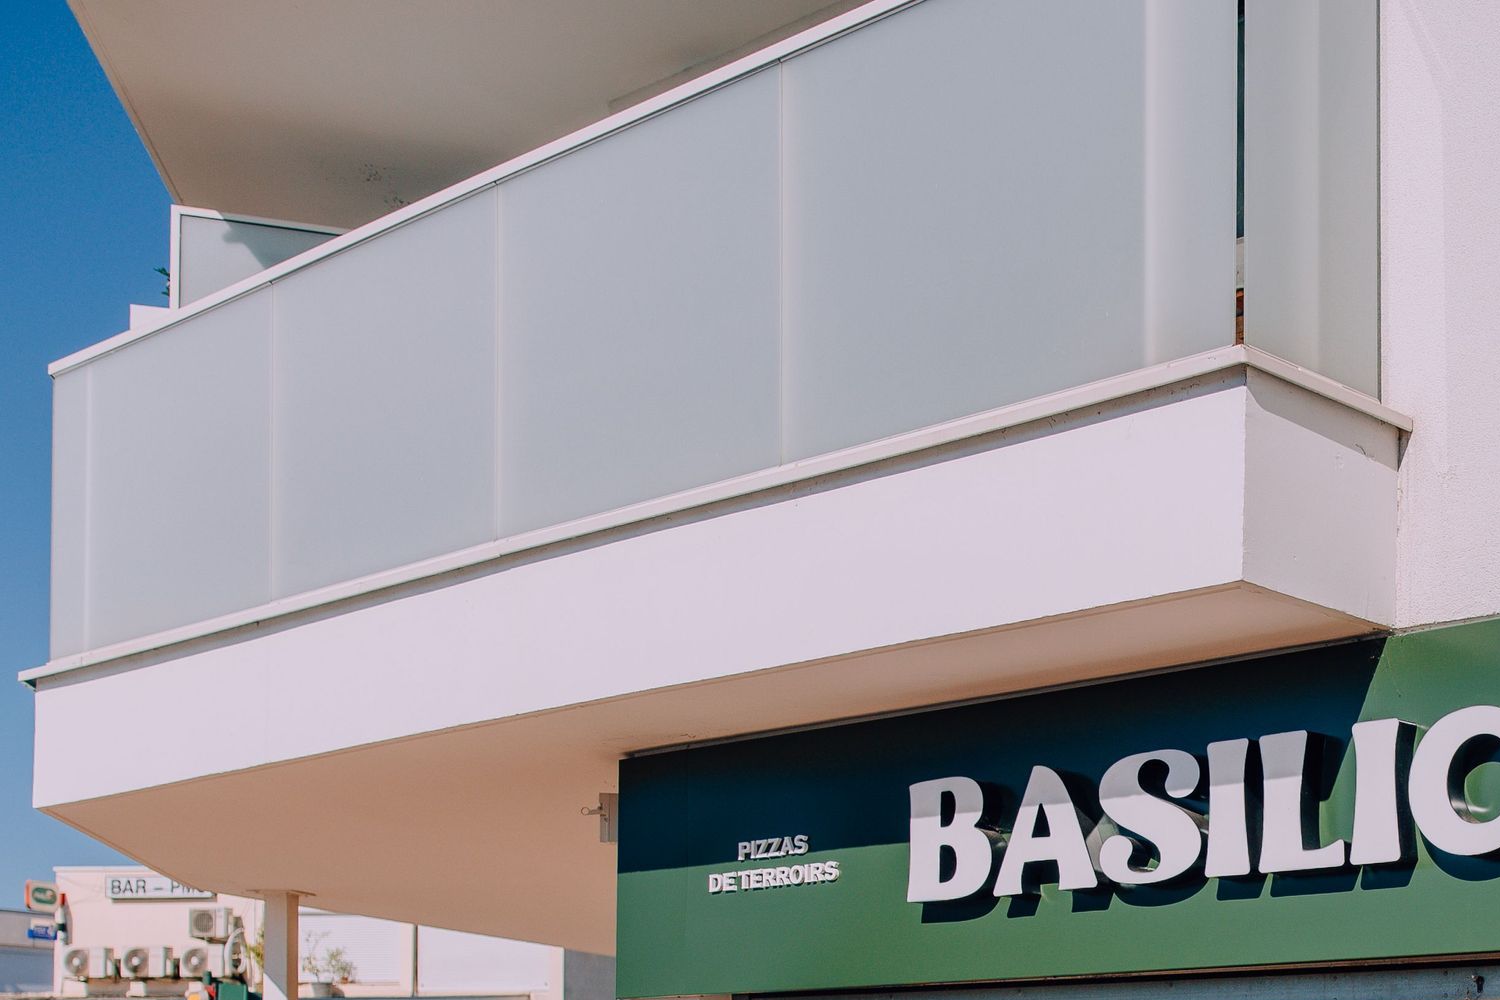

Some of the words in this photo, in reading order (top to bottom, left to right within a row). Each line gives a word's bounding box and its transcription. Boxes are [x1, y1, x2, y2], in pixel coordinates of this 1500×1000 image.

[737, 834, 809, 861] PIZZAS
[111, 879, 147, 894] BAR
[708, 871, 738, 893] DE
[738, 860, 840, 890] TERROIRS
